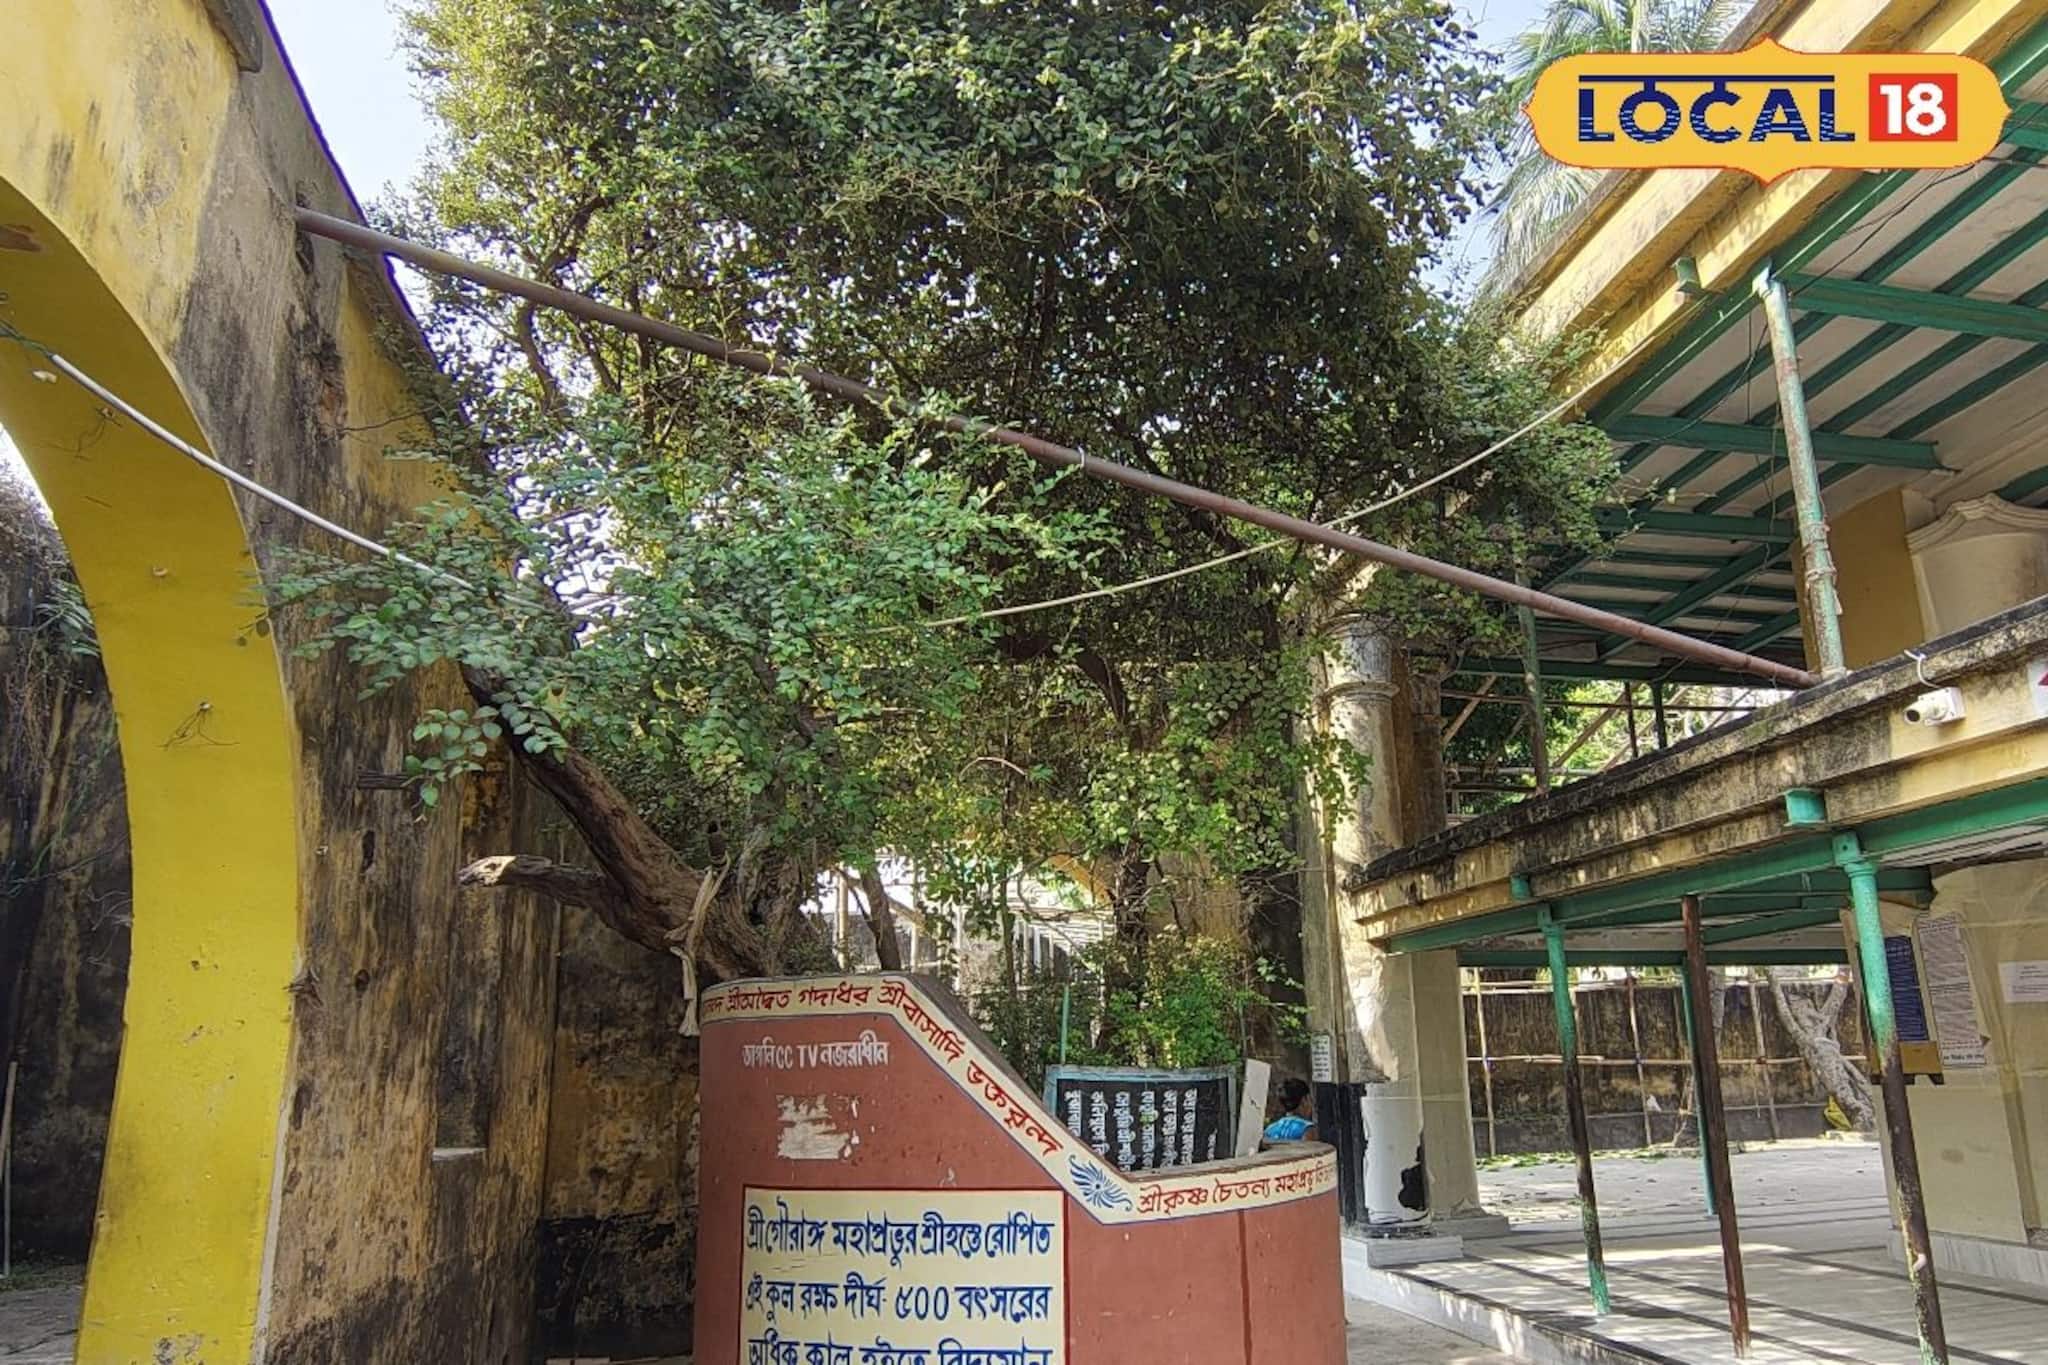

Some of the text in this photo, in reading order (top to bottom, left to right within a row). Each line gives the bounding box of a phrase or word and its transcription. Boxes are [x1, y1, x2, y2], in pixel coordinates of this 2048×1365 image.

[798, 981, 873, 1007] গদাধর
[832, 1210, 919, 1269] মহাপ্রভুর
[985, 1211, 1055, 1258] রোপিত
[895, 1286, 950, 1321] ৫০০
[954, 1286, 1053, 1323] বৎসরের
